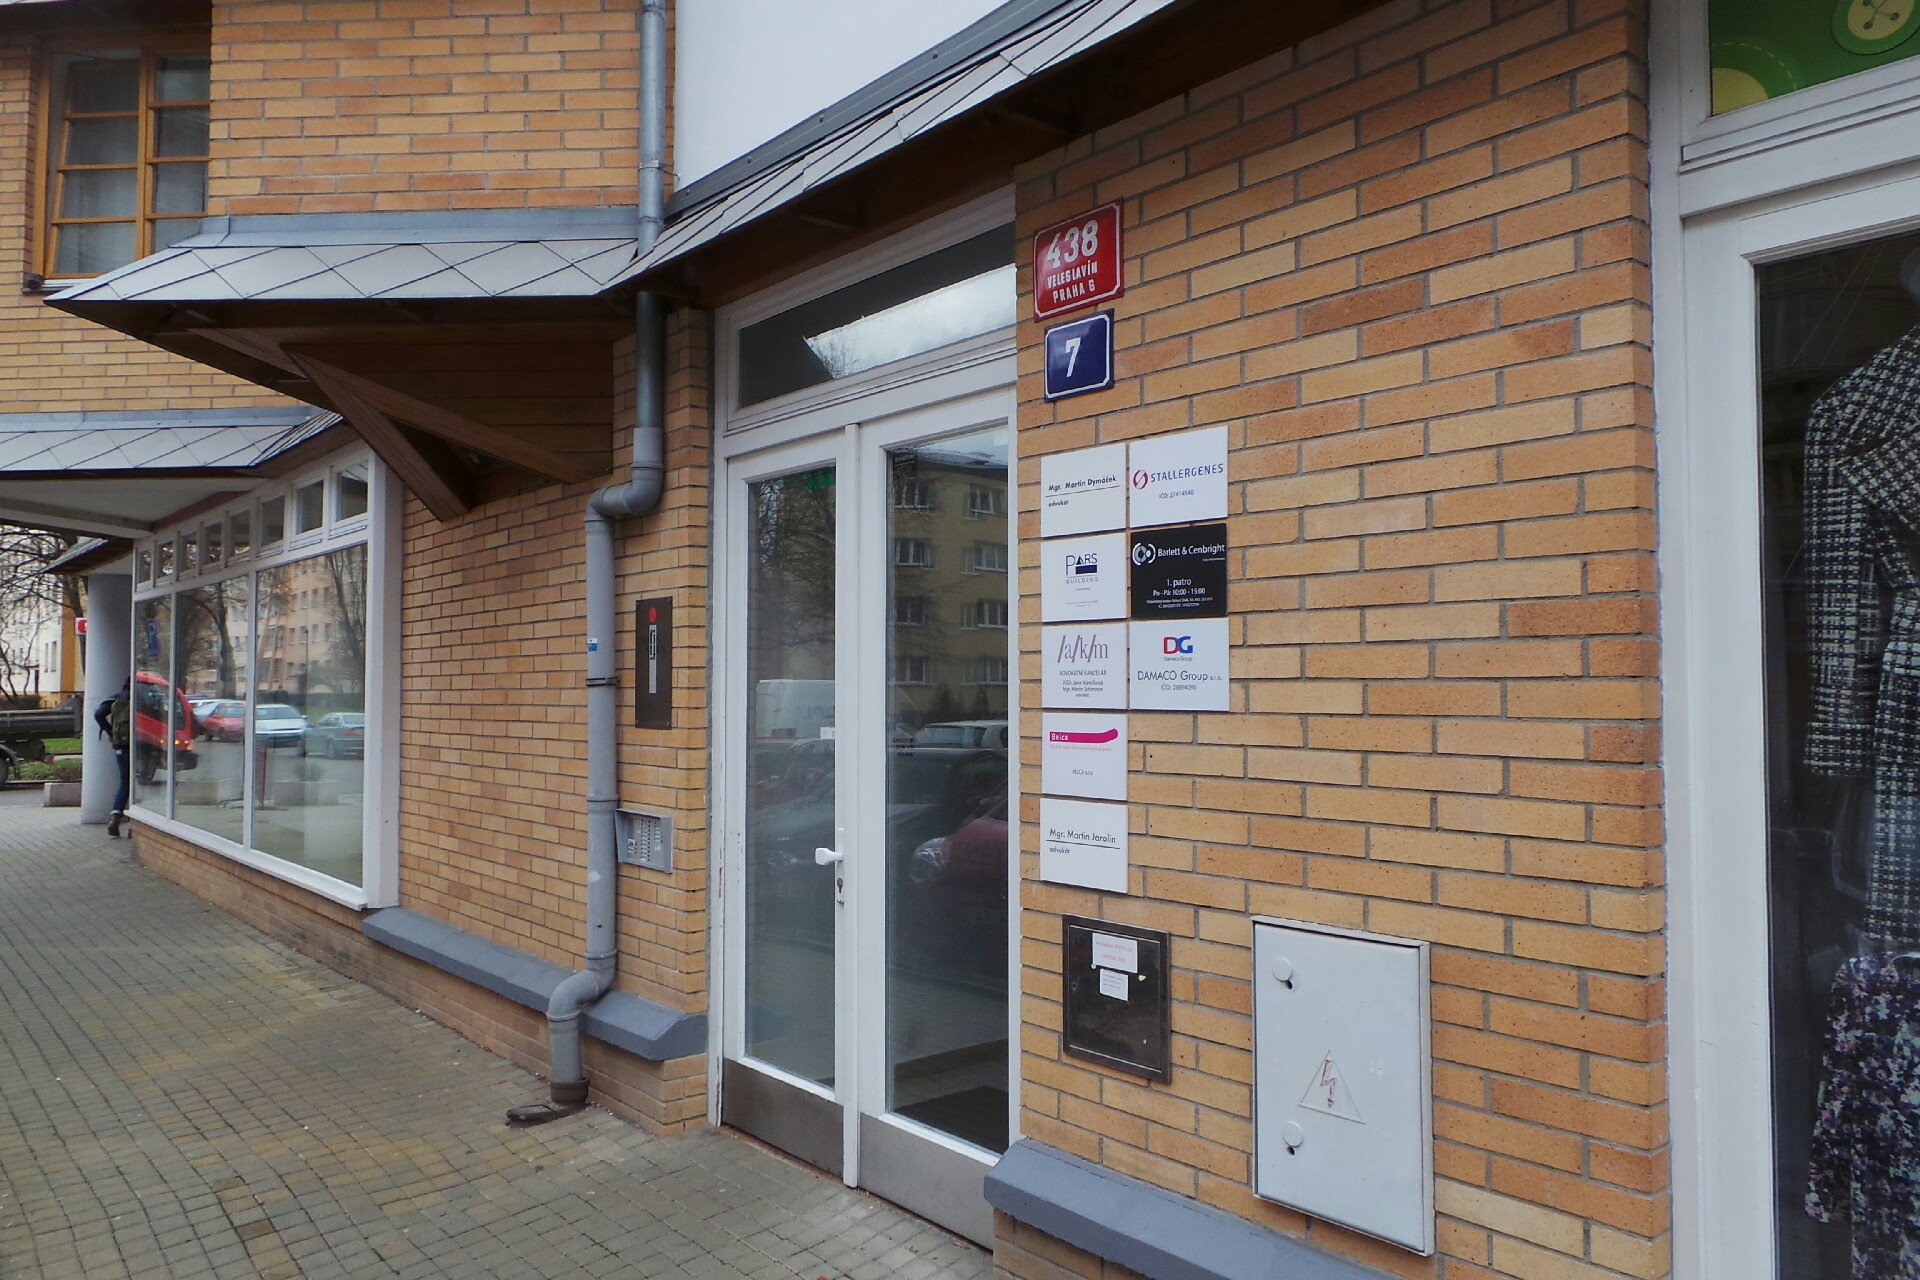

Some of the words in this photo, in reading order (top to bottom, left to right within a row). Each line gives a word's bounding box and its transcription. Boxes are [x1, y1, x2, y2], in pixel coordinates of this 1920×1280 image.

[1046, 220, 1099, 269] 438
[1046, 259, 1098, 289] VELESLAVÍN
[1052, 283, 1086, 304] PRAHA
[1088, 279, 1096, 292] 6
[1065, 337, 1081, 378] 7
[1150, 463, 1224, 483] STALLERGENES
[1065, 480, 1086, 489] Martin
[1087, 474, 1117, 487] Dymáček
[1157, 547, 1181, 558] Barlett
[1181, 546, 1187, 555] &
[1188, 543, 1225, 555] Cenbright
[1065, 553, 1098, 576] PARS
[1065, 577, 1099, 585] BUILDING
[1166, 578, 1172, 587] 1.
[1173, 578, 1192, 588] patro
[1172, 588, 1187, 596] 10:00
[1191, 587, 1206, 595] 15:00
[1163, 635, 1194, 655] DG
[1137, 670, 1178, 681] DAMACO
[1180, 670, 1208, 683] Group
[1051, 733, 1069, 741] Belca
[1049, 828, 1066, 840] Mgr.
[1067, 829, 1090, 841] Martin
